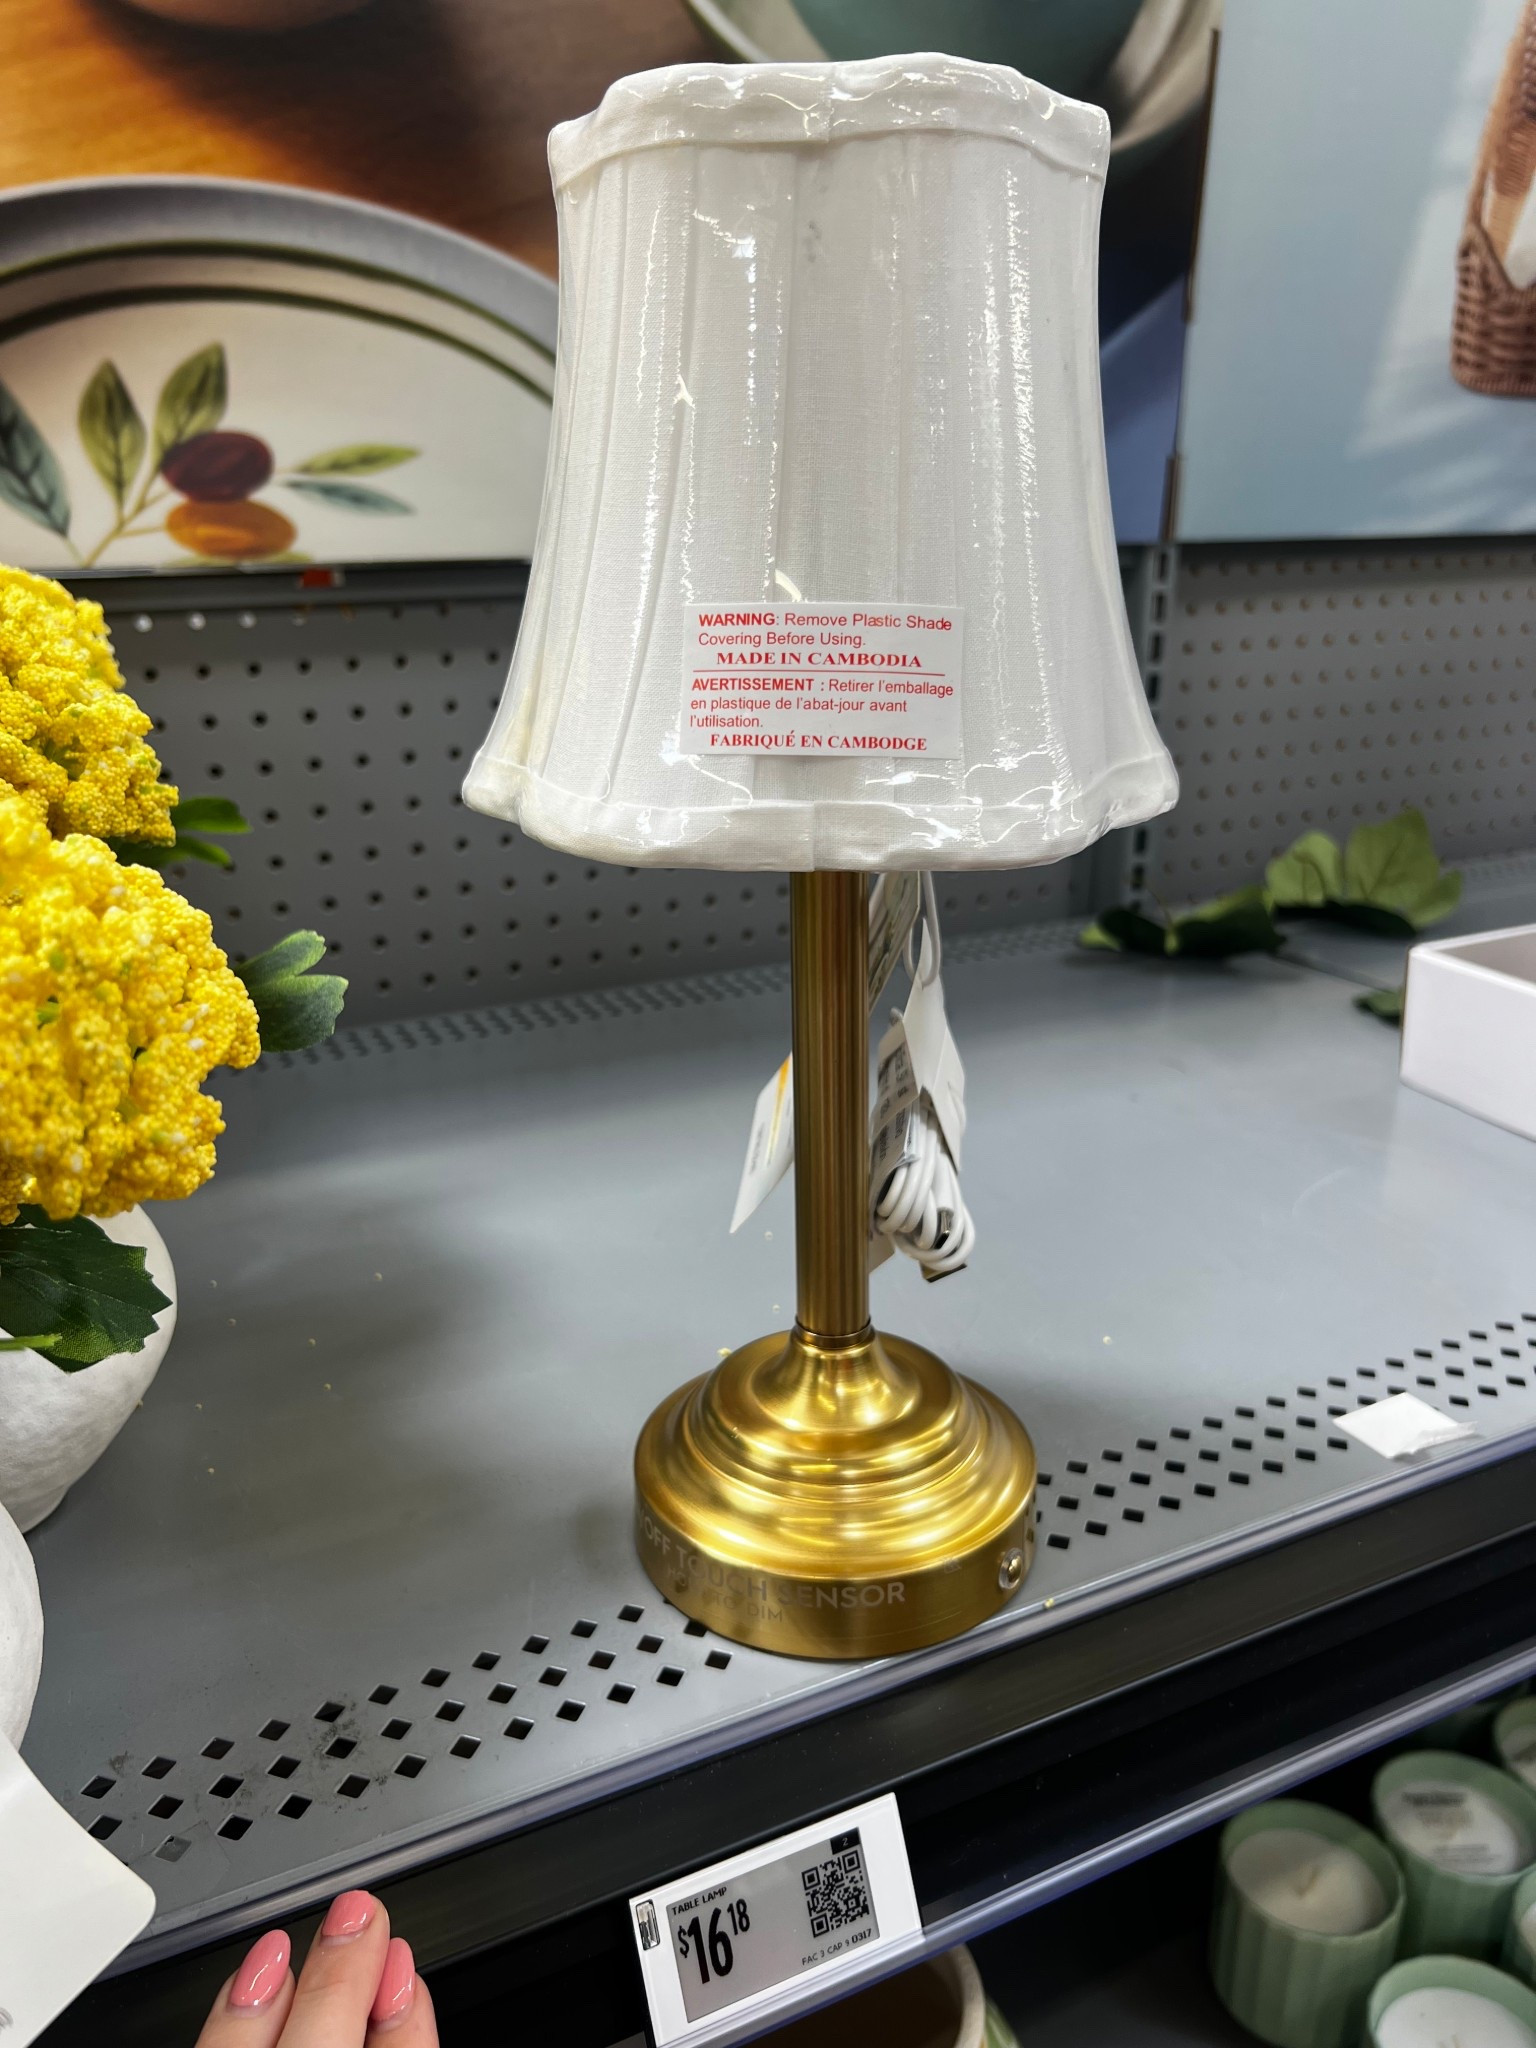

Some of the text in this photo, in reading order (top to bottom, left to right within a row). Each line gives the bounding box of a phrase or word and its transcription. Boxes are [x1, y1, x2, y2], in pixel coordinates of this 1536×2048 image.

[699, 613, 952, 630] WARNING: Remove Plastic Shade
[699, 633, 866, 648] Covering Before Using.
[717, 652, 922, 668] MADE IN CAMBODIA
[691, 678, 814, 692] AVERTISSEMENT
[829, 679, 874, 693] Retirer
[878, 680, 954, 698] l'emballage
[690, 698, 907, 714] en plastique de l'abat-jour avant
[690, 715, 763, 728] l'utilisation.
[710, 730, 927, 751] FABRIQUÉ EN CAMBODGE
[675, 1545, 767, 1601] TOUCH
[777, 1582, 906, 1610] SENSOR
[747, 1602, 783, 1622] DIM
[672, 1886, 727, 1915] TABLE LAMP
[802, 1953, 818, 1966] FAC
[827, 1942, 842, 1954] CAP
